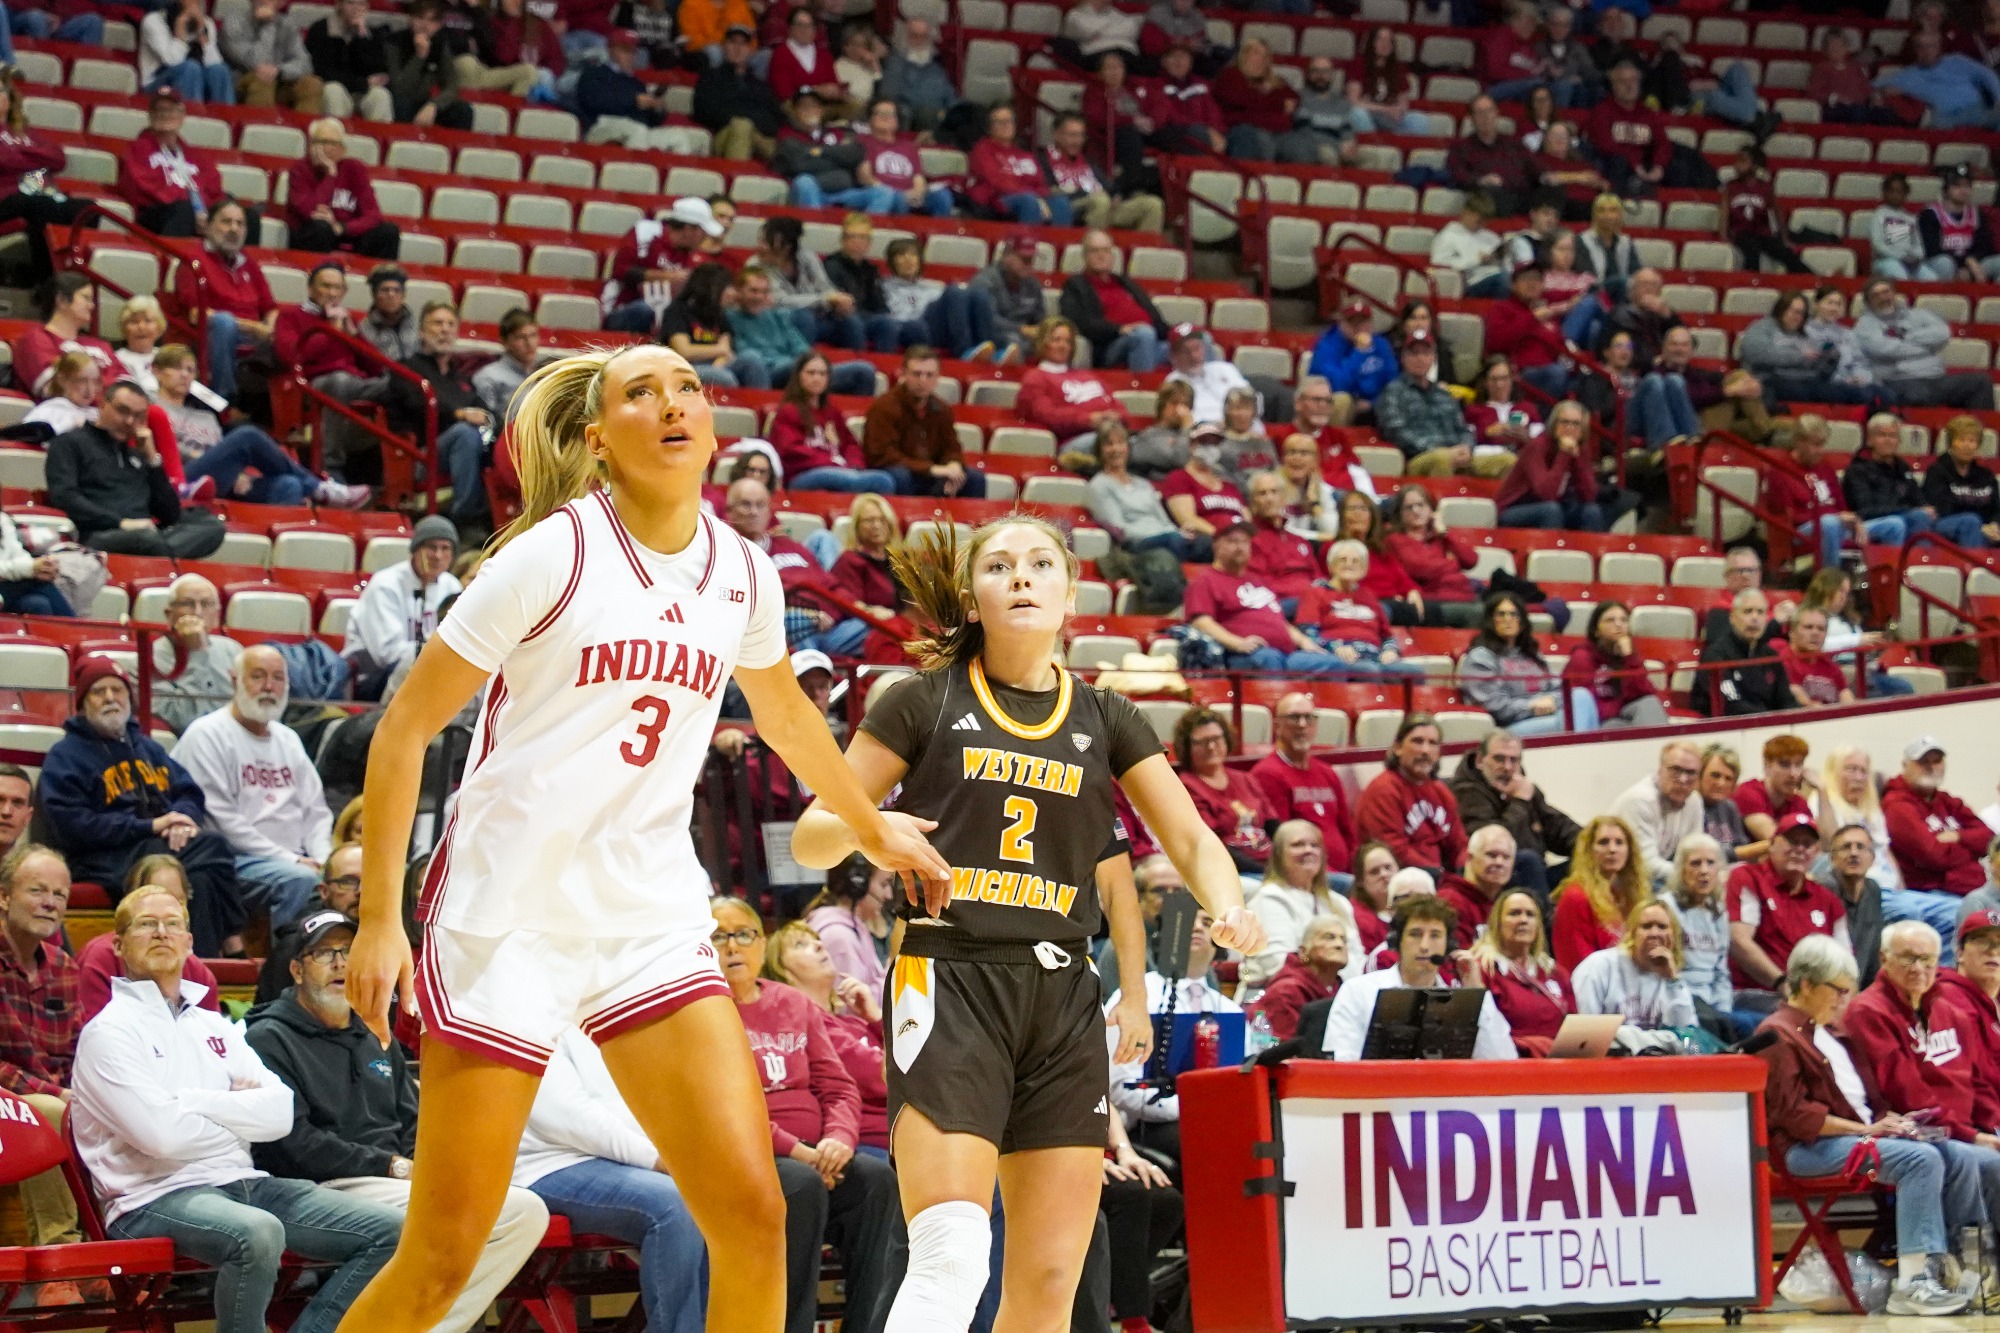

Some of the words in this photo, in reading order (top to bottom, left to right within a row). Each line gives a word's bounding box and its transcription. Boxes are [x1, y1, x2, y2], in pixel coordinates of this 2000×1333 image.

[620, 695, 671, 767] 3
[963, 747, 1084, 798] WESTERN
[999, 795, 1039, 865] 2
[951, 867, 1078, 918] MICHIGAN
[1343, 1104, 1697, 1229] INDIANA
[1388, 1226, 1661, 1299] BASKETBALL
